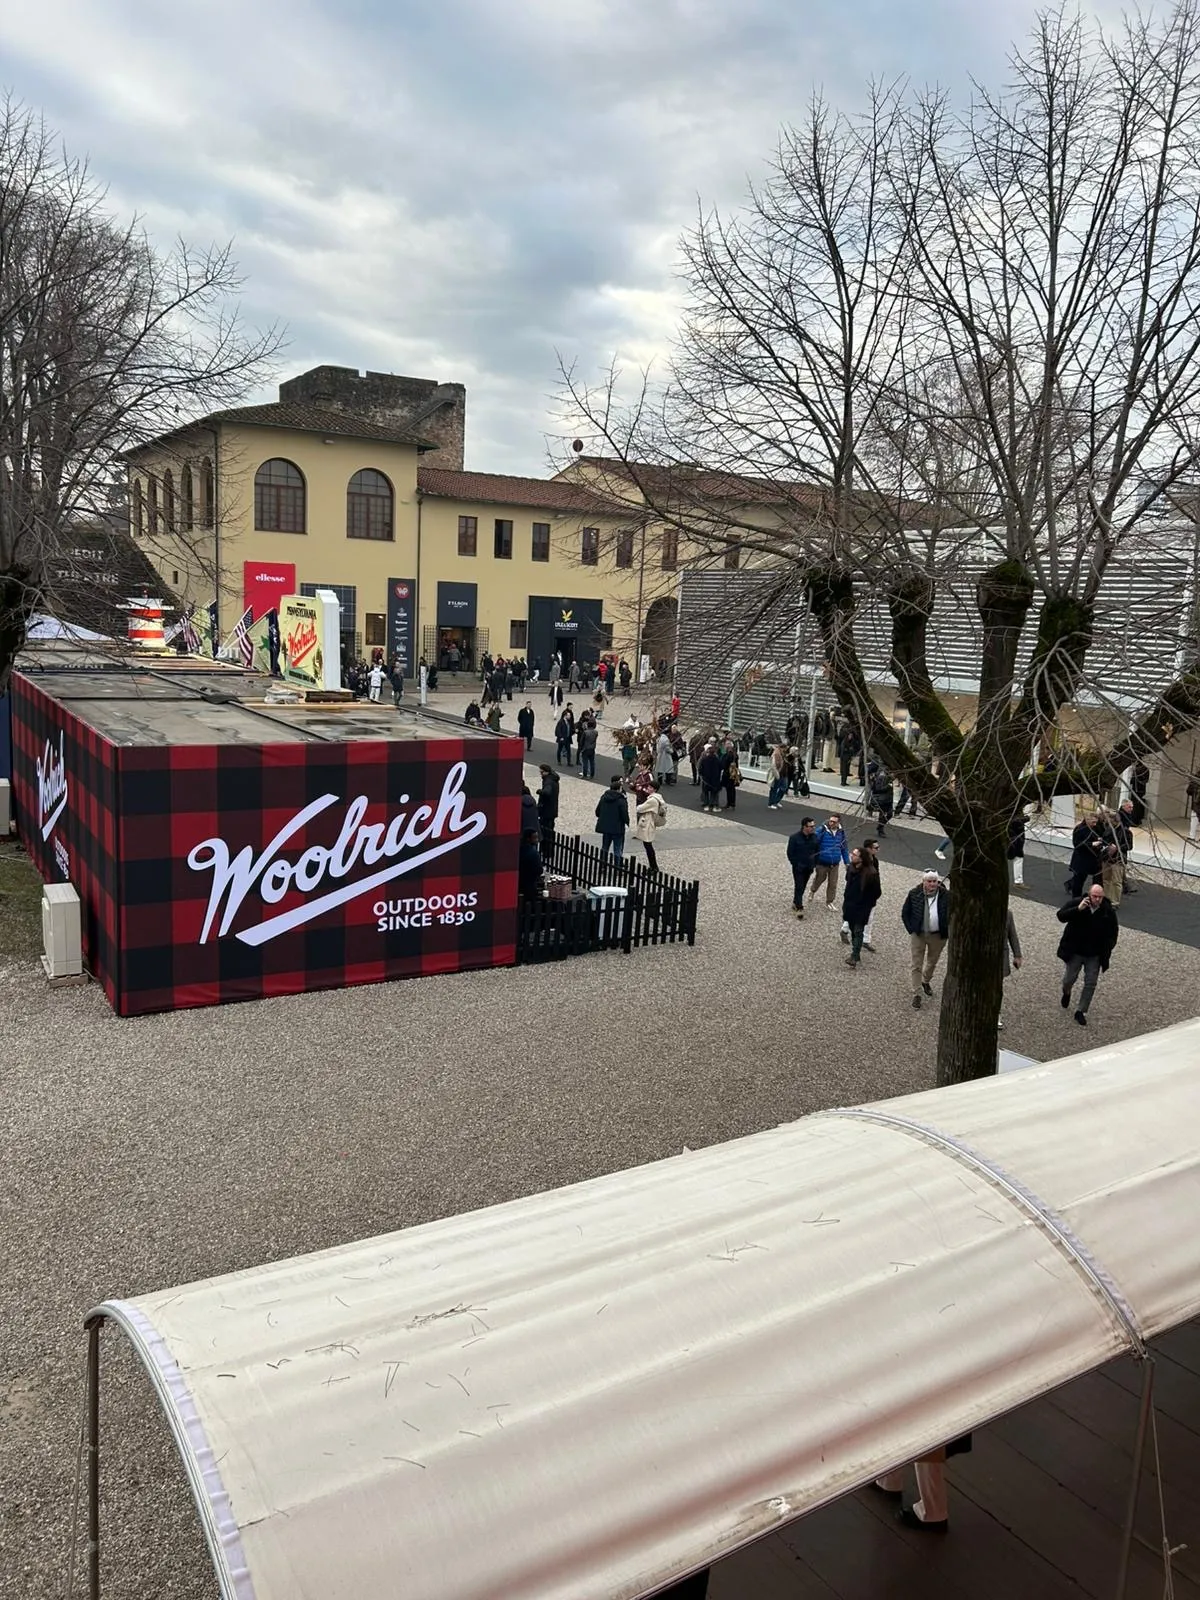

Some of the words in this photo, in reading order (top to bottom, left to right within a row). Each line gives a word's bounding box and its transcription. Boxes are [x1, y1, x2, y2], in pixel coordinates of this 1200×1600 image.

[256, 574, 285, 582] ellesse
[187, 761, 487, 946] Woolrich
[373, 892, 478, 916] OUTDOORS
[377, 911, 432, 932] SINCE
[437, 910, 476, 925] 1830
